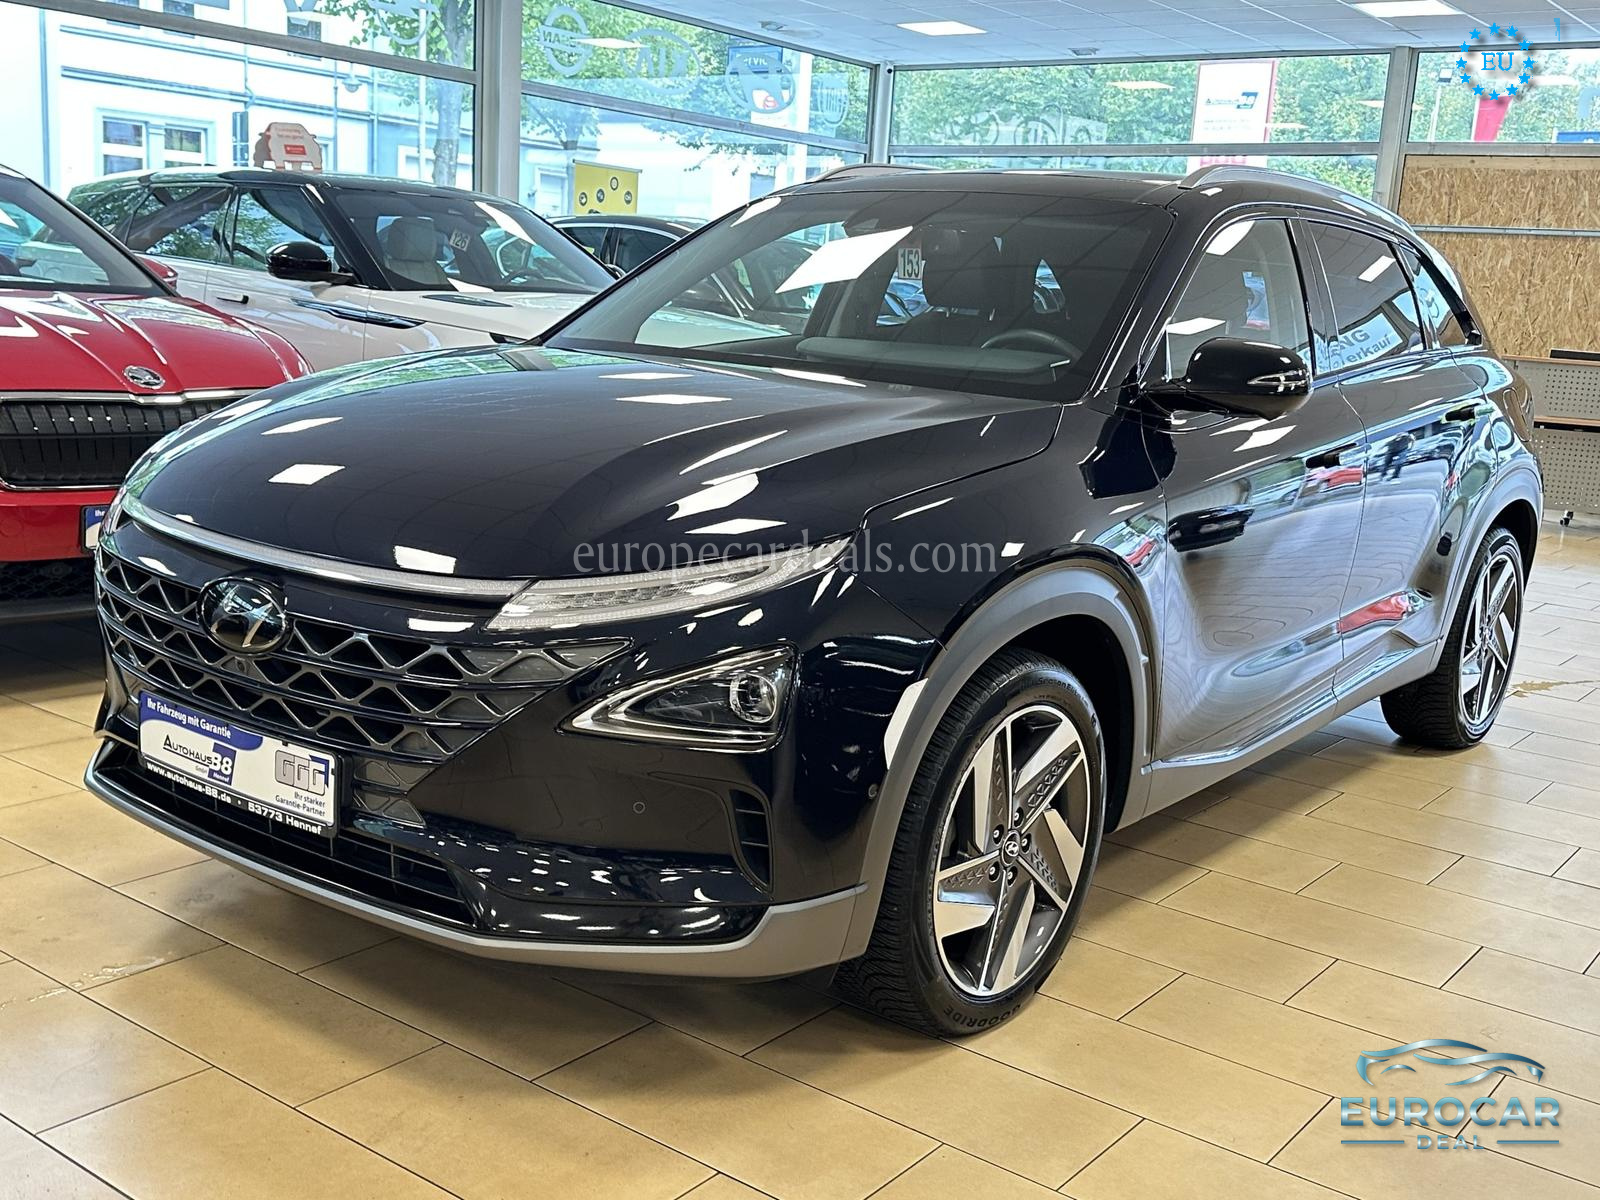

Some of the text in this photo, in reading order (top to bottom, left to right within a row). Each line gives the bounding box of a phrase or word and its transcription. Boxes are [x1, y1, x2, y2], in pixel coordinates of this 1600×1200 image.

[900, 248, 920, 278] 153
[147, 697, 231, 739] Ihr Fahrzeug mit Garantie
[275, 794, 326, 817] Garantie-Partner
[294, 791, 326, 808] Ihr starker
[247, 802, 283, 822] 53773
[285, 815, 322, 835] Hennef
